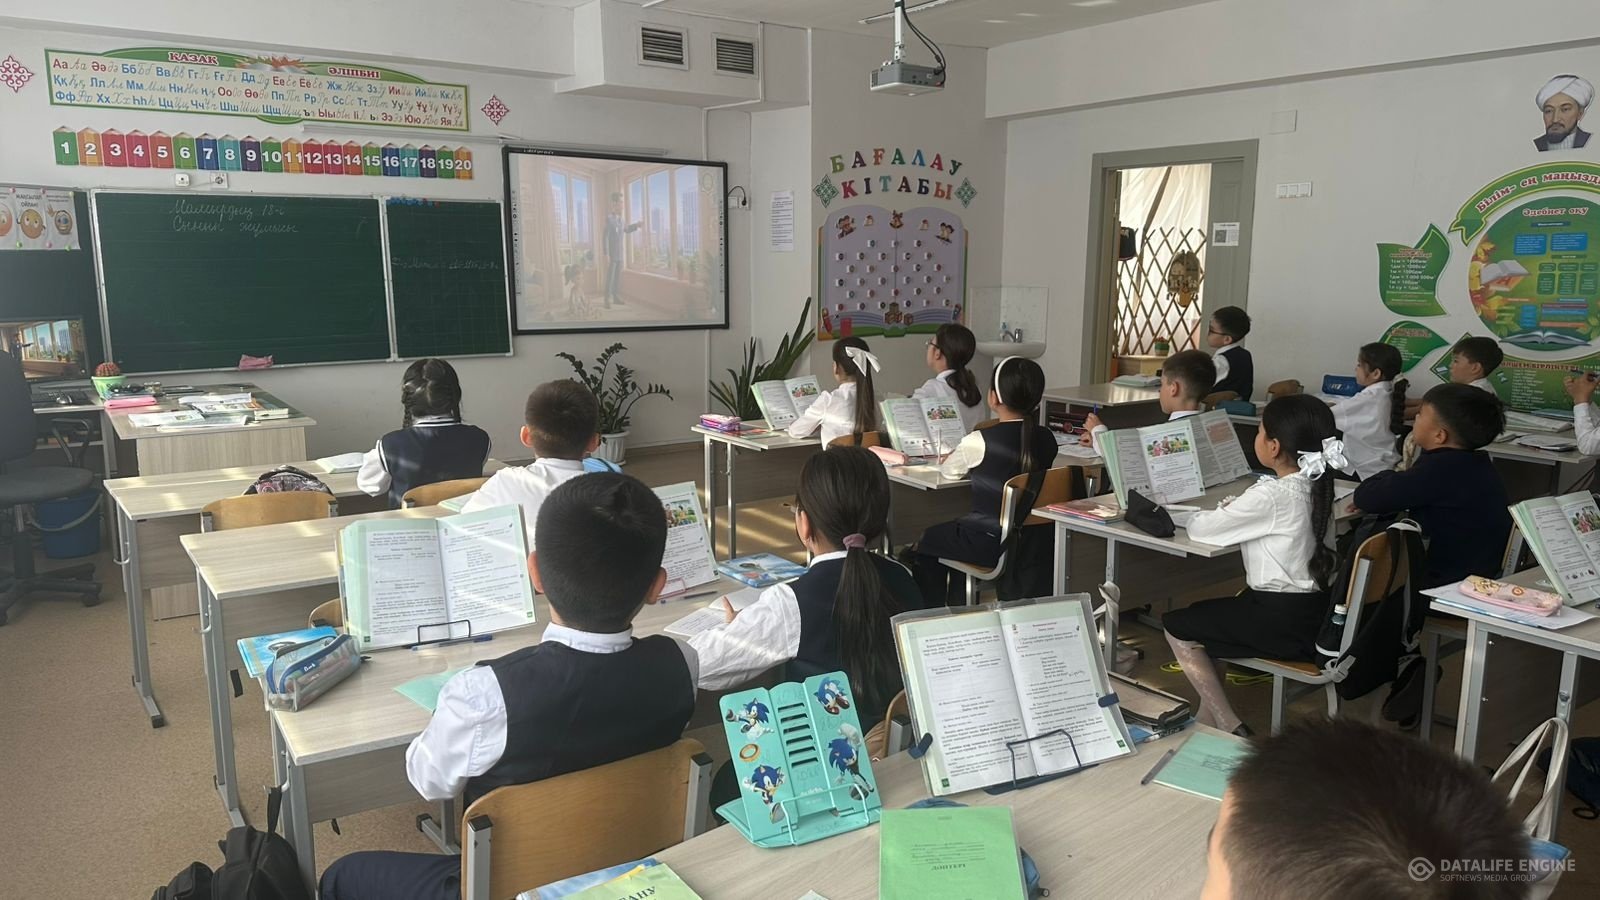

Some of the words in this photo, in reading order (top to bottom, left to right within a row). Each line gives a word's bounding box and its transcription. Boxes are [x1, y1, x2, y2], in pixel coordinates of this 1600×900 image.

[53, 58, 68, 70] Аа
[121, 63, 137, 74] Бб
[156, 66, 171, 77] Вв
[326, 80, 342, 90] Жж
[126, 80, 144, 90] Мм
[168, 83, 183, 93] Нн
[217, 86, 233, 97] Оо
[271, 91, 285, 100] Пп
[304, 93, 317, 105] Рр
[332, 95, 344, 105] Сс
[55, 90, 76, 104] Фф
[96, 93, 111, 104] Хх
[220, 101, 239, 112] Шш
[404, 114, 421, 124] Юю
[61, 142, 70, 153] 1
[85, 143, 97, 155] 2
[110, 143, 121, 156] 3
[133, 144, 144, 157] 4
[157, 146, 168, 158] 5
[180, 147, 191, 159] 6
[203, 148, 213, 159] 7
[224, 149, 235, 161] 8
[246, 150, 257, 161] 9
[262, 151, 281, 162] 10
[285, 151, 302, 163] 11
[304, 152, 322, 164] 12
[324, 153, 342, 165] 13
[344, 154, 361, 166] 14
[364, 155, 380, 166] 15
[383, 156, 399, 167] 16
[402, 157, 417, 168] 17
[420, 157, 436, 169] 18
[438, 158, 454, 169] 19
[455, 159, 472, 170] 20
[830, 148, 962, 175] БАҒАЛАУ
[841, 176, 953, 200] КІТАБЫ
